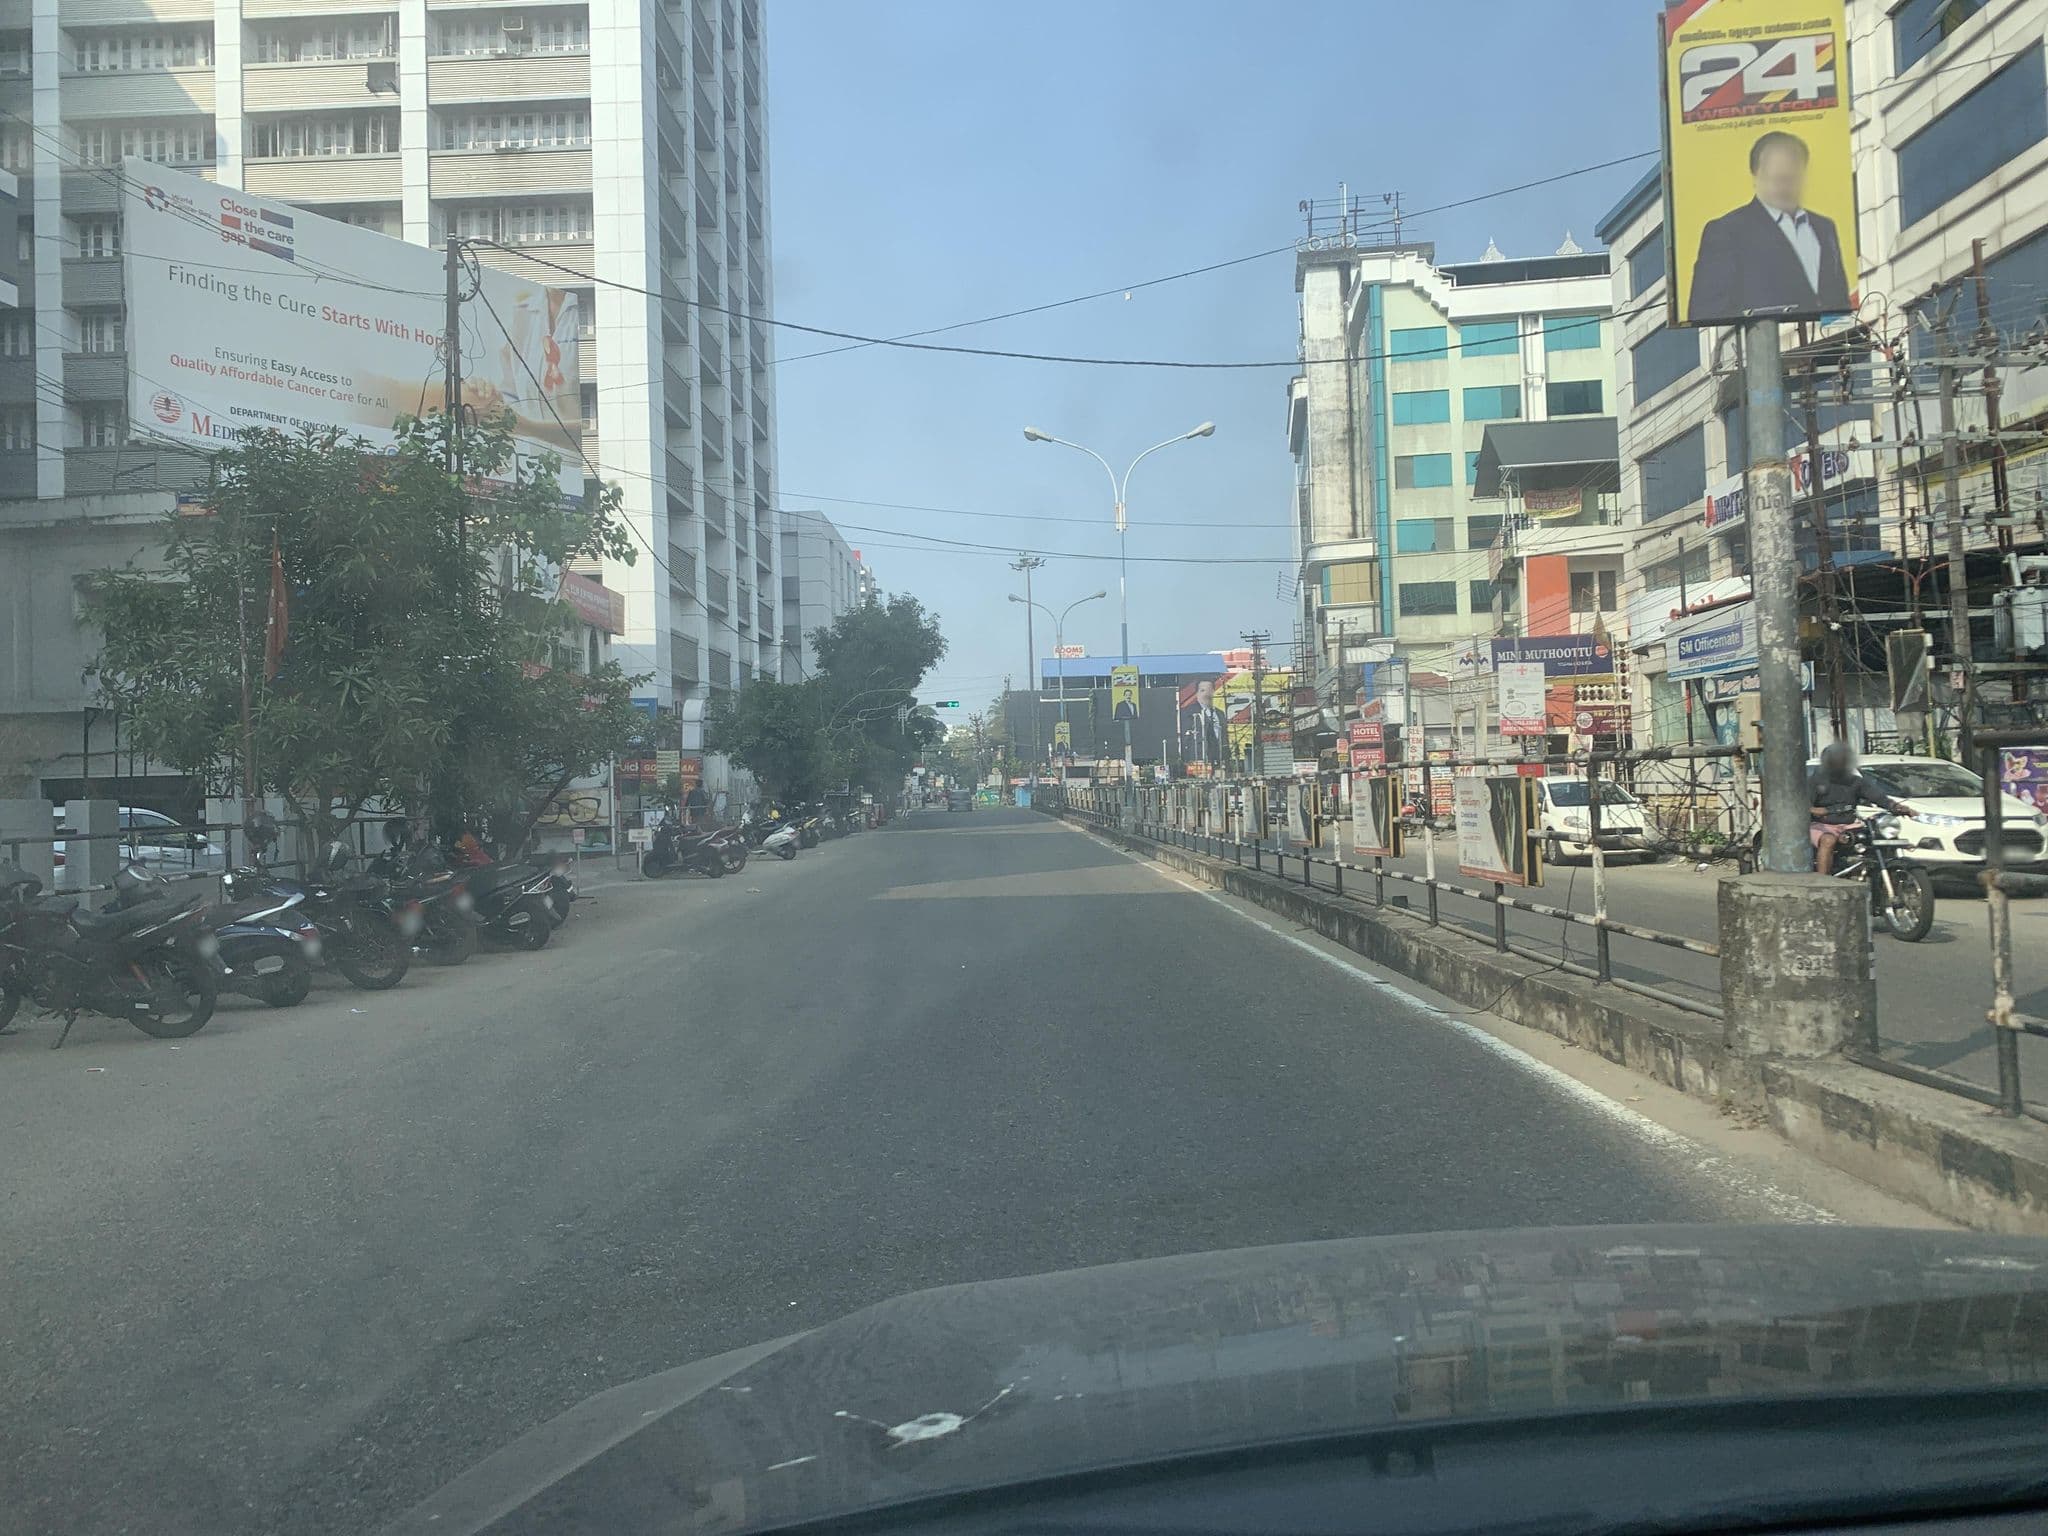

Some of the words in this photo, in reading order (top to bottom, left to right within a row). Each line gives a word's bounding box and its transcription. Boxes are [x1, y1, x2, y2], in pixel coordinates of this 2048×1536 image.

[1681, 34, 1836, 113] 24
[1684, 104, 1774, 122] TWENTY
[220, 198, 258, 218] Close
[221, 229, 246, 245] gap
[244, 221, 265, 236] the
[267, 229, 294, 244] care
[168, 265, 238, 301] Finding
[243, 285, 272, 306] the
[278, 294, 317, 318] Cure
[322, 305, 370, 330] Starts
[375, 317, 410, 339] With
[215, 347, 268, 370] Ensuring
[271, 359, 298, 377] Easy
[300, 366, 338, 384] Access
[341, 375, 352, 387] to
[170, 354, 217, 376] Quality
[219, 365, 284, 388] Affordable
[287, 379, 327, 398] Cancer
[329, 388, 354, 402] Care
[357, 392, 373, 406] for
[375, 397, 389, 409] All
[230, 406, 288, 425] DEPARTMENT
[1525, 647, 1593, 660] MUTHOOTTU
[1353, 727, 1380, 736] HOTEL
